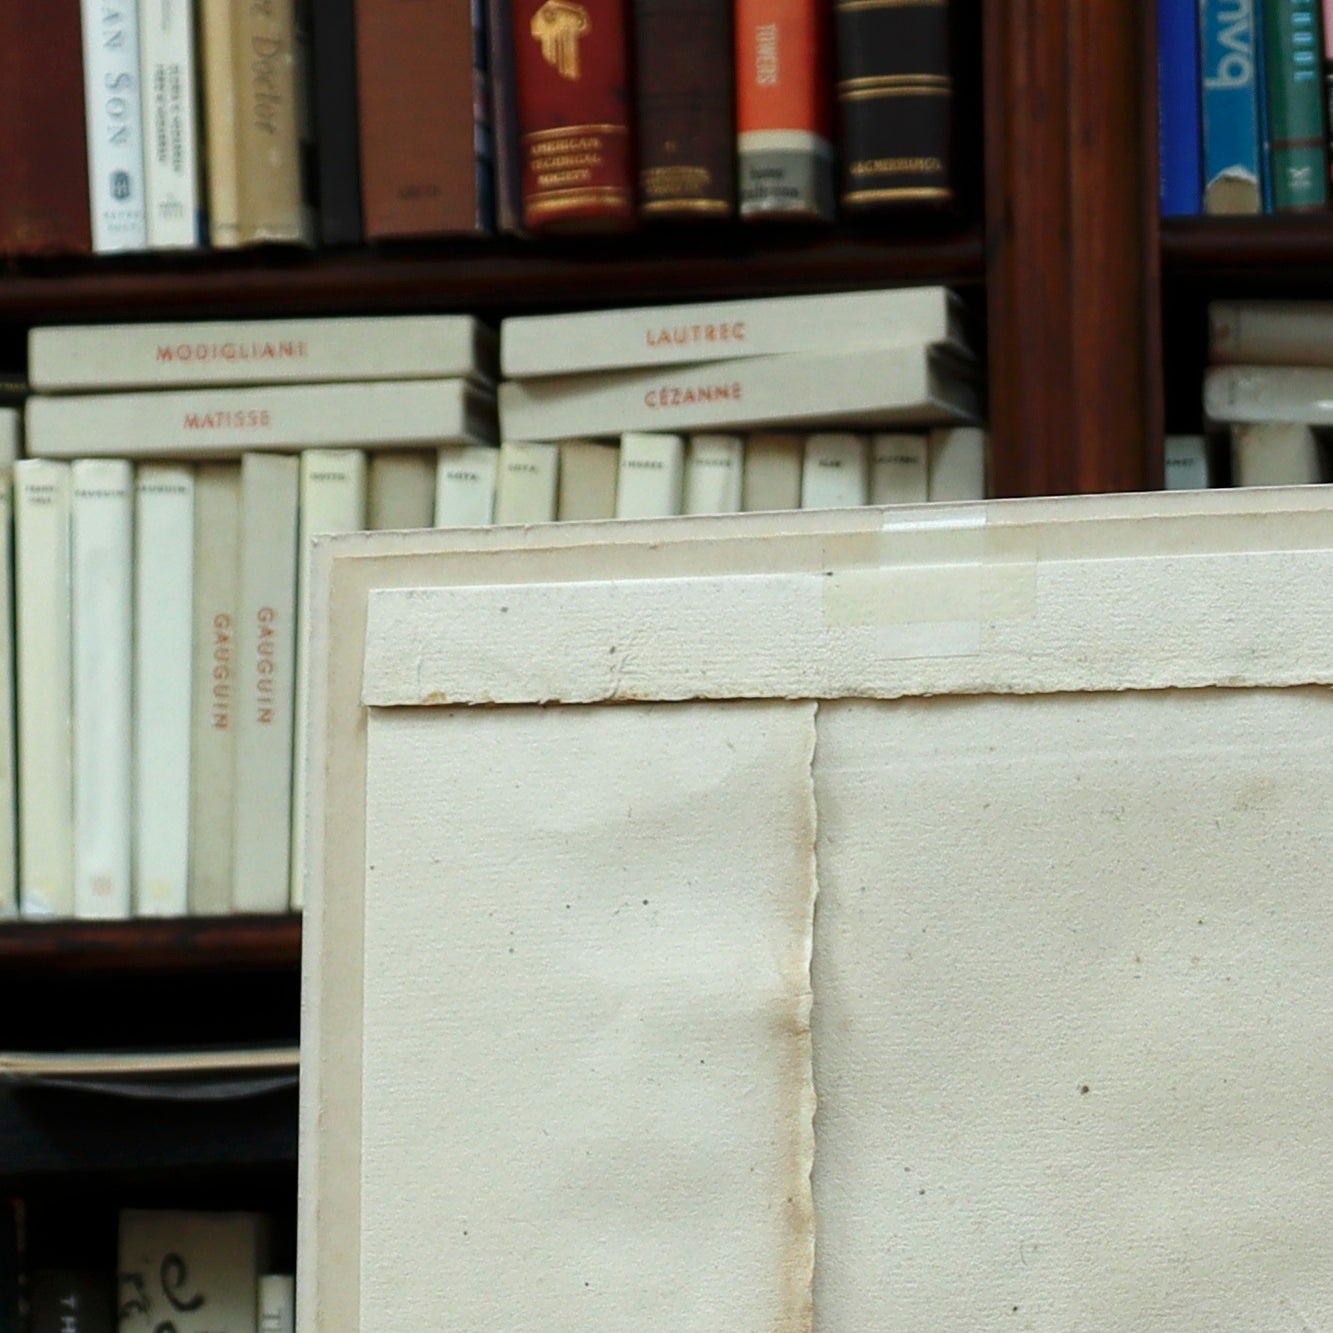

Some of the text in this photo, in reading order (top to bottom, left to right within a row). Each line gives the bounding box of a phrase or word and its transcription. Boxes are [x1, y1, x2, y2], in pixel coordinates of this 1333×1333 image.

[105, 72, 137, 147] SON
[645, 321, 747, 348] LAUTREC
[155, 342, 308, 363] MODIGLIANI
[643, 381, 743, 409] CÉZANNE
[182, 408, 271, 431] MATISSE
[212, 612, 231, 732] GAUGUIN
[256, 606, 276, 725] GAUGUIN
